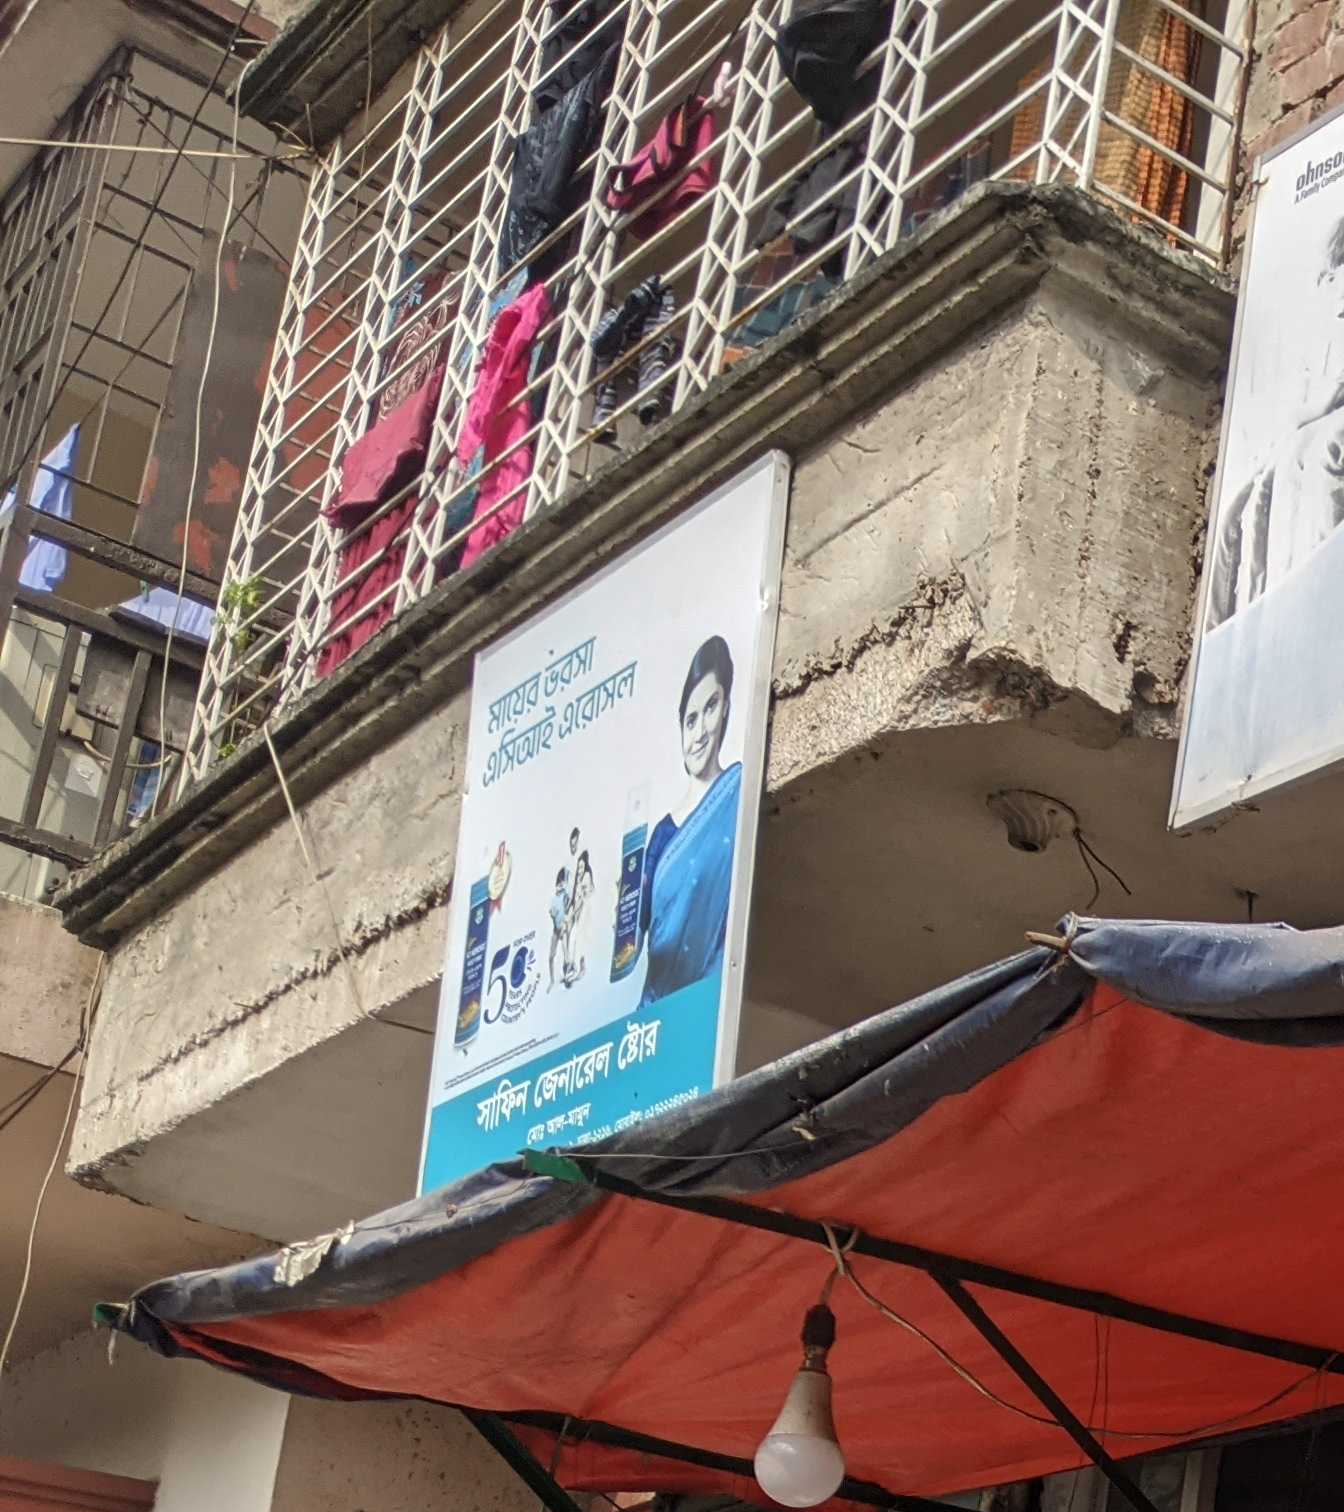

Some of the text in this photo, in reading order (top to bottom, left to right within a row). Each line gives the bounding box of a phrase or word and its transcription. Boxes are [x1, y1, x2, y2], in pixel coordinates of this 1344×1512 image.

[483, 661, 637, 787] এসিআই এরোসল
[488, 636, 596, 733] মায়ের ভরসা
[477, 1079, 530, 1131] সাফিন
[535, 1042, 614, 1107] জেনারেল
